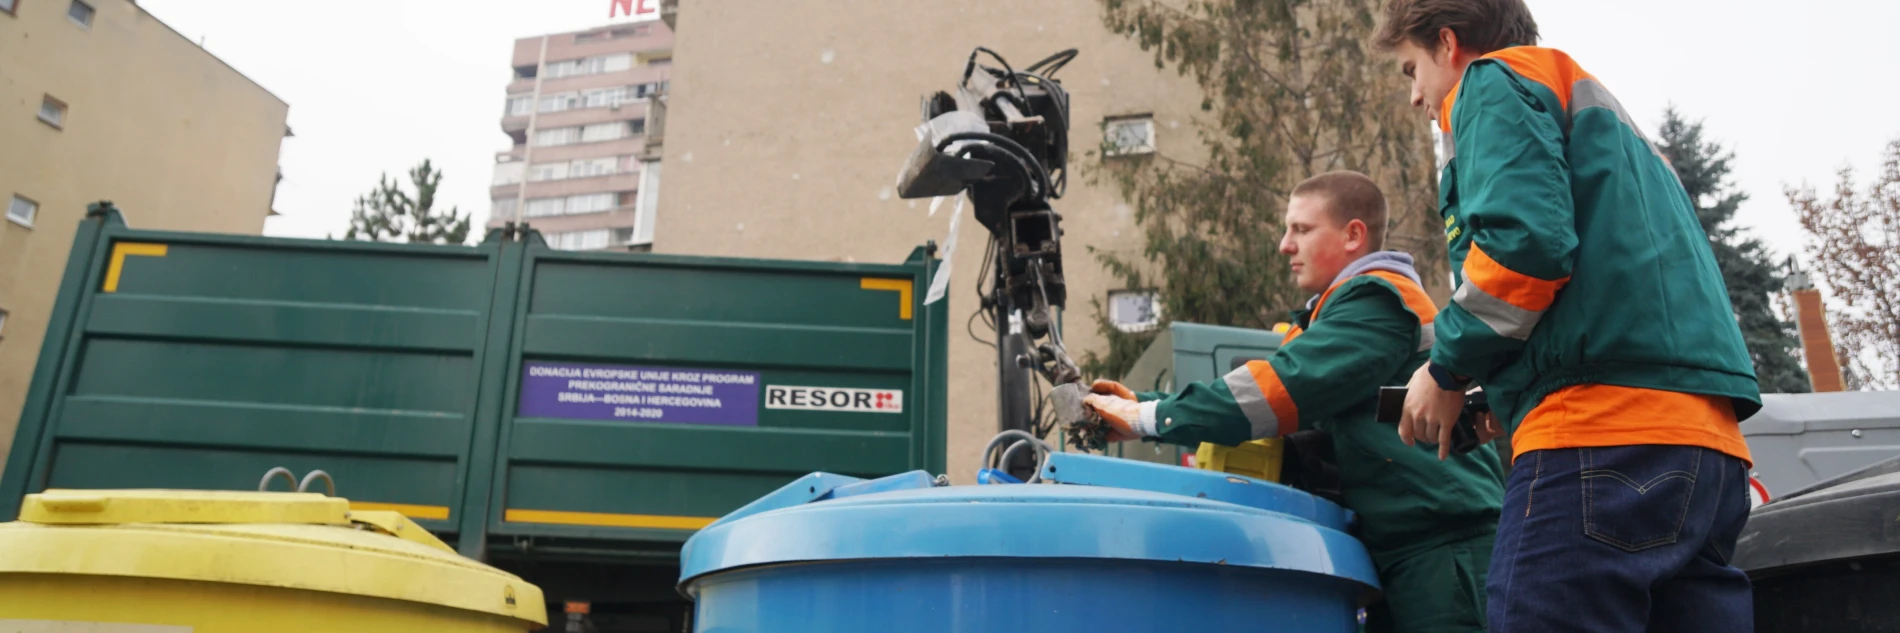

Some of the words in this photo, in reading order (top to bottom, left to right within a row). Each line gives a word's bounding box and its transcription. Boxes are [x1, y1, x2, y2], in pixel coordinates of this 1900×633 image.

[529, 366, 581, 378] DONACIJA
[583, 368, 638, 380] EVROPSKE
[640, 370, 669, 382] UNIJE
[672, 371, 700, 383] KROZ
[702, 373, 754, 385] PROGRAM
[568, 379, 656, 393] PREKOGRANIČNE
[658, 382, 713, 395] SARADNJE
[641, 395, 646, 405] I
[647, 395, 722, 408] HERCEGOVINA
[769, 389, 872, 408] RESOR
[614, 406, 663, 419] 2014-2020
